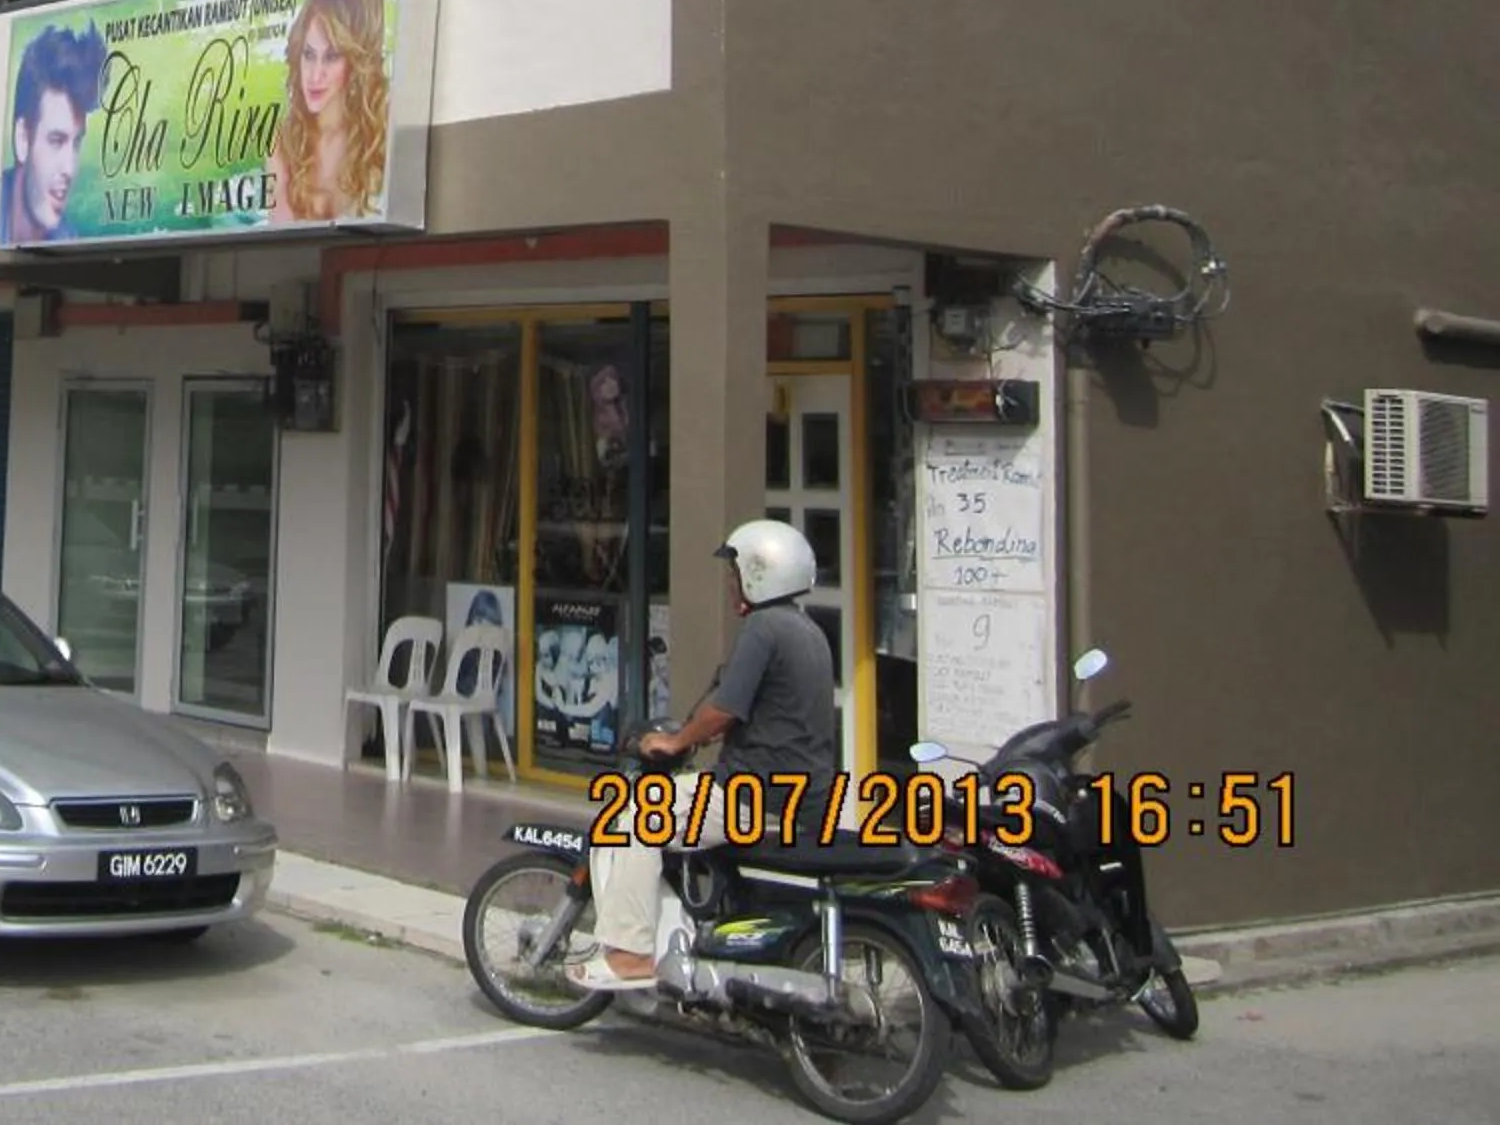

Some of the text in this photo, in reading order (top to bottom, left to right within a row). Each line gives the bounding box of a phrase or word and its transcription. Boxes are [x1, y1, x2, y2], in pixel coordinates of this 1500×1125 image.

[105, 17, 137, 44] PUSAT
[138, 4, 204, 39] KECANTIKAN
[102, 50, 169, 178] Cha
[103, 172, 278, 222] NEW IMAGE
[957, 491, 987, 514] 35
[143, 853, 187, 876] 6229
